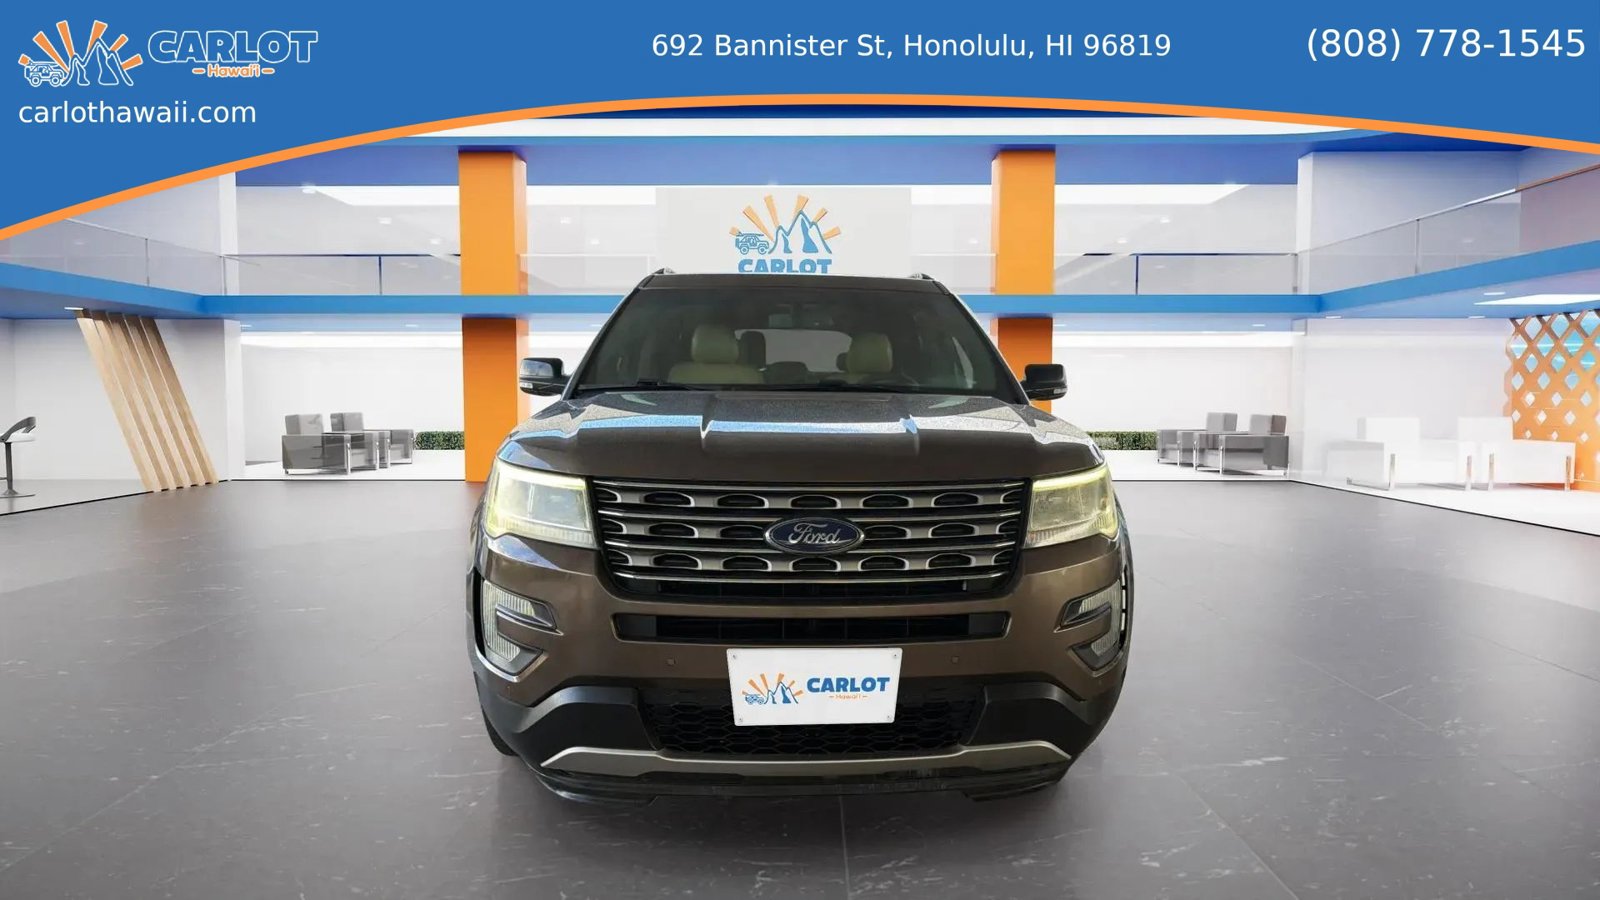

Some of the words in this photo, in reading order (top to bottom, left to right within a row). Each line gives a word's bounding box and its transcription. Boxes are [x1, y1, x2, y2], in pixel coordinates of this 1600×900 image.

[738, 259, 832, 273] CARLOT
[788, 522, 841, 544] Ford
[806, 677, 890, 693] CARLOT
